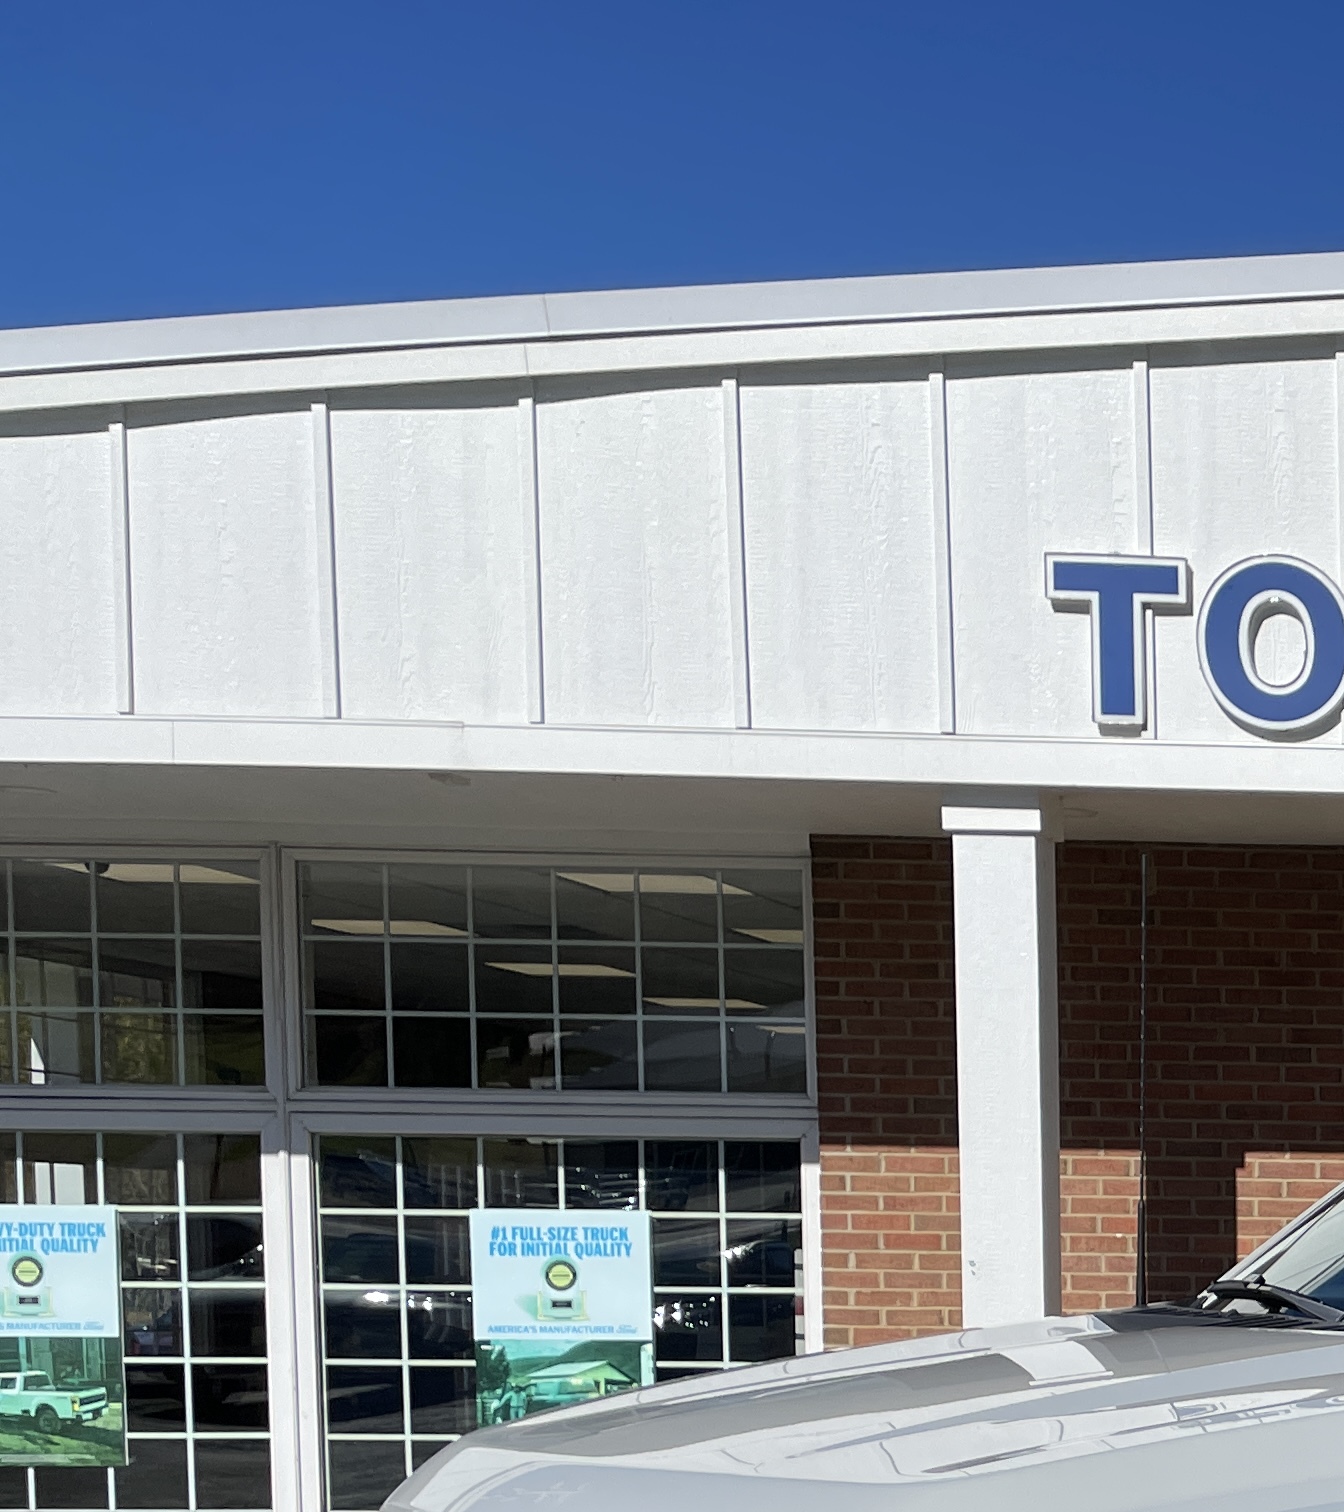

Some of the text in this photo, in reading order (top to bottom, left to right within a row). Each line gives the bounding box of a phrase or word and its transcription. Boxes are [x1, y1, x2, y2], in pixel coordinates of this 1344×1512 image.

[59, 1221, 107, 1238] TRUCK
[490, 1226, 629, 1242] #1 FULL-SIZE TRUCK
[41, 1237, 99, 1256] QUALITY
[489, 1241, 633, 1260] FOR INITIAL QUALITY
[487, 1324, 538, 1334] AMERICA'S
[539, 1325, 614, 1334] MANUFACTURER
